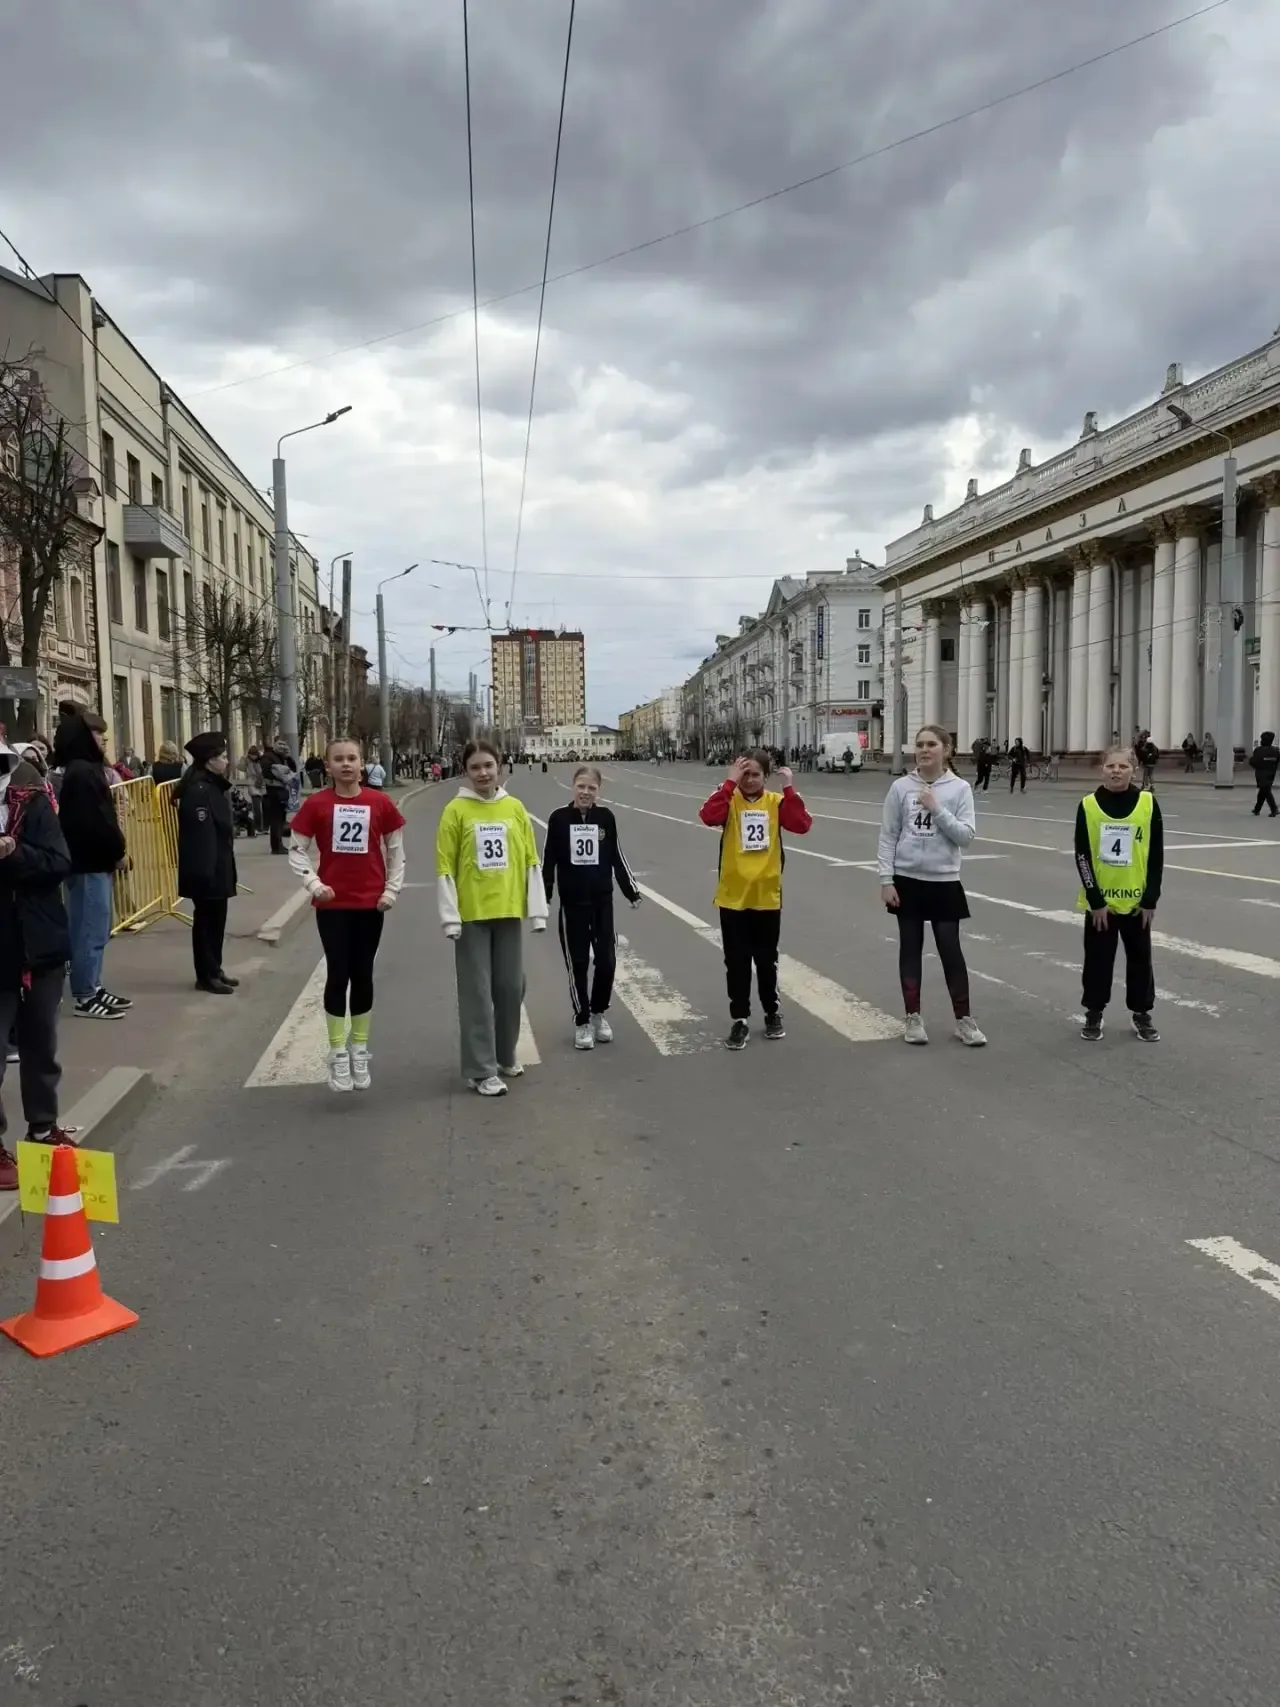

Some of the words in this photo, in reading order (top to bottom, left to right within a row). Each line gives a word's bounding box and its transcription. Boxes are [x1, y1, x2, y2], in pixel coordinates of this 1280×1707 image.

[988, 497, 1127, 563] ПЛАЗА
[914, 812, 932, 829] 44
[340, 821, 363, 842] 22
[747, 824, 764, 841] 23
[1135, 826, 1142, 843] 4
[484, 839, 503, 859] 33
[576, 838, 593, 856] 30
[1111, 838, 1121, 856] 4
